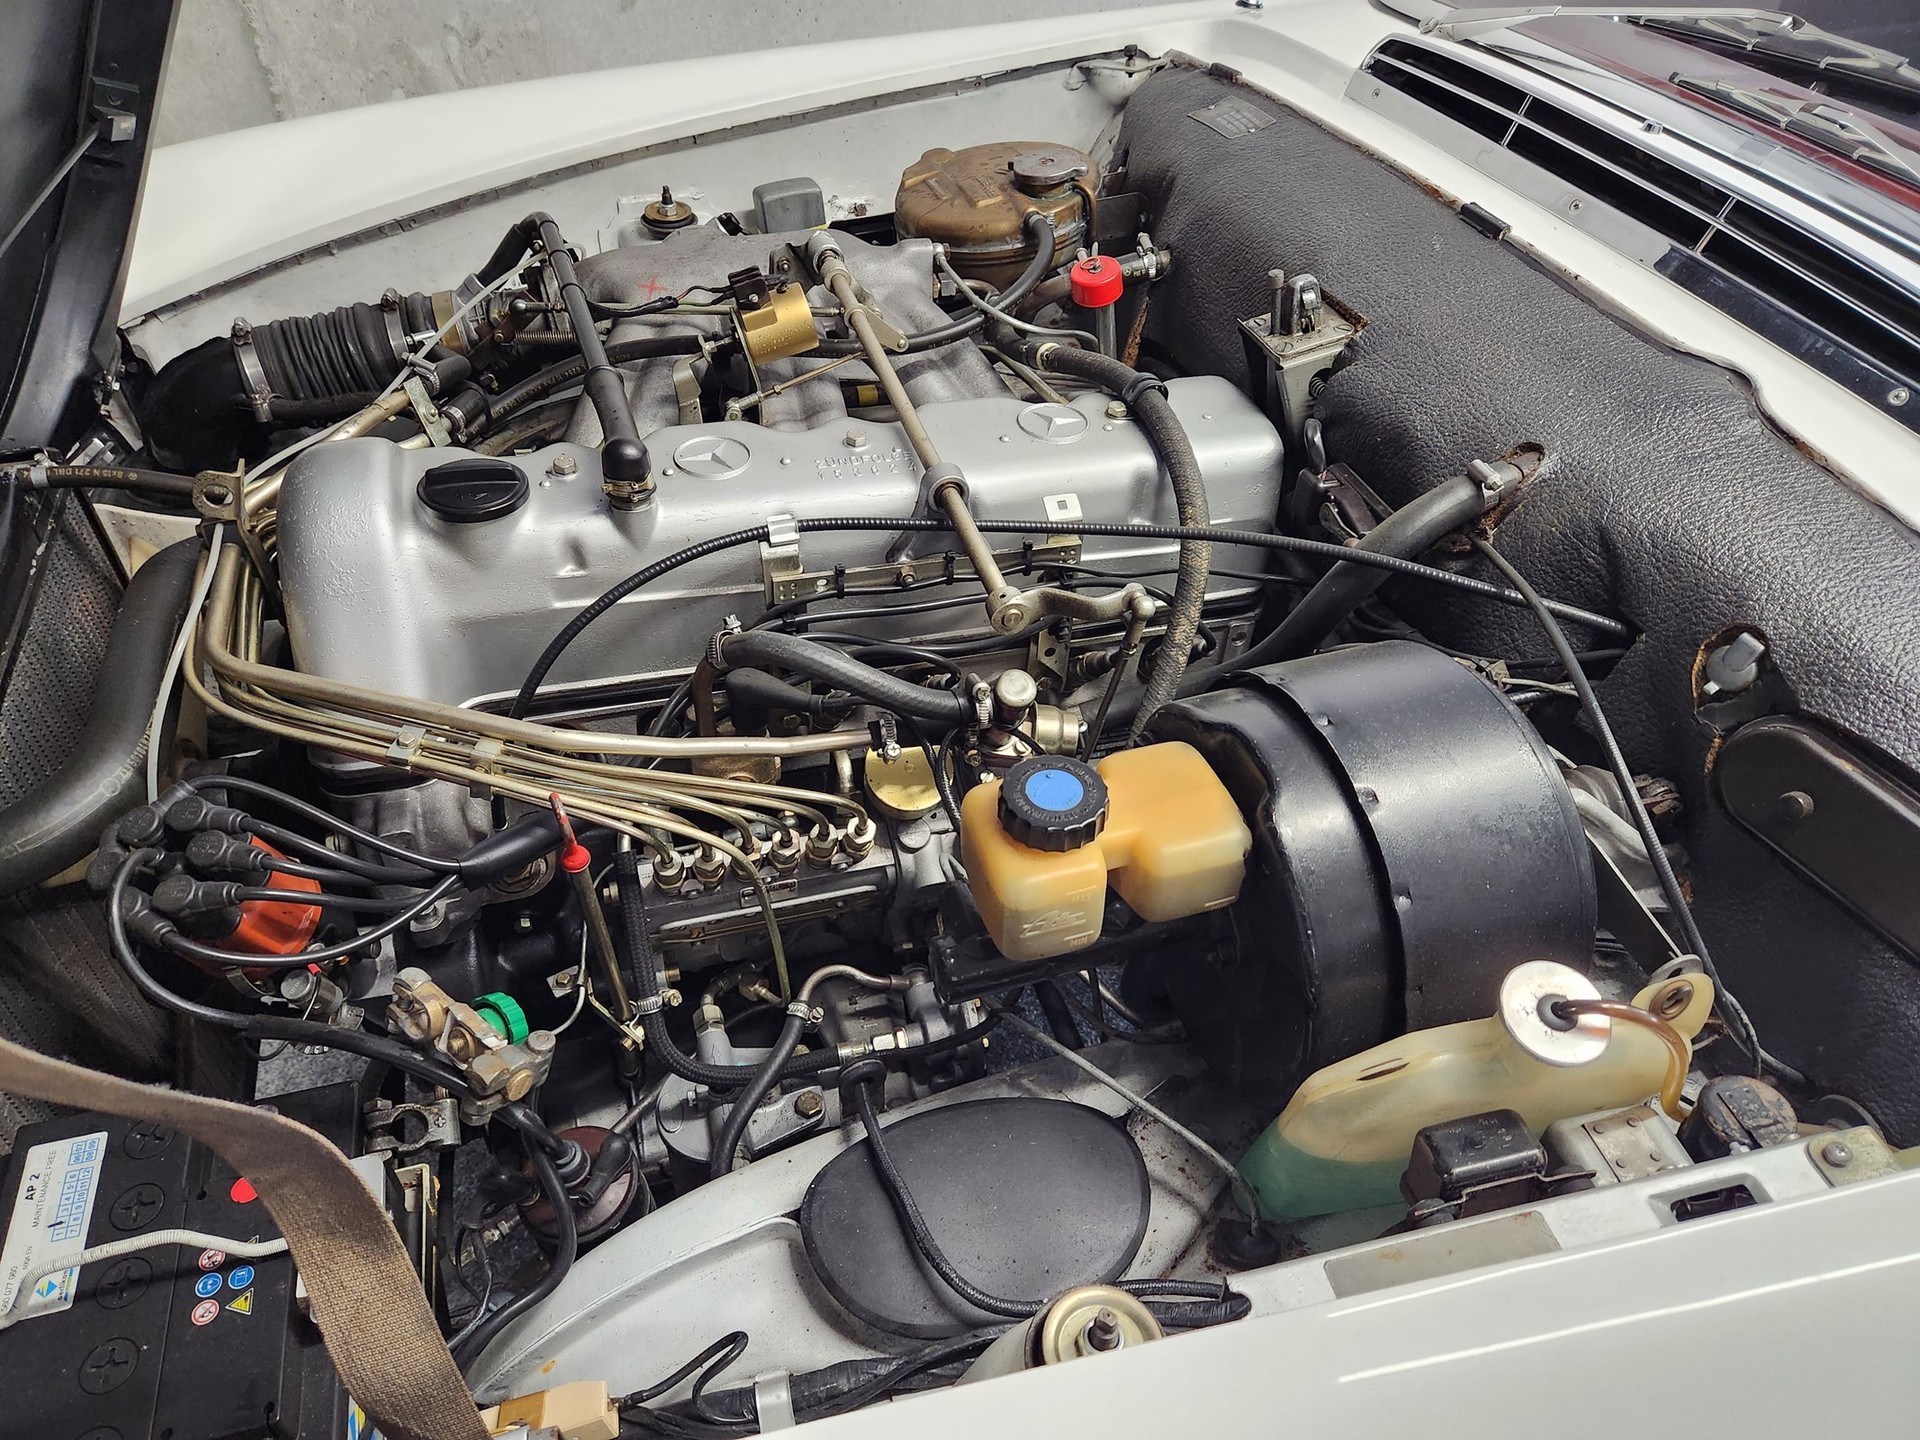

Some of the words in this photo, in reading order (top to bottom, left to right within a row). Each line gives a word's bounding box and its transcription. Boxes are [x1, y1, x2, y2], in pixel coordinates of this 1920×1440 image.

[814, 450, 914, 468] ZÜNDFOLGE
[30, 1173, 40, 1182] 2
[82, 1169, 91, 1178] 12
[32, 1172, 52, 1229] MAINTENANCE
[46, 1149, 57, 1170] FREE
[80, 1180, 88, 1189] 11
[25, 1185, 36, 1200] AP
[77, 1191, 86, 1201] 10
[4, 1282, 14, 1296] 077
[58, 1269, 69, 1301] oerlikon
